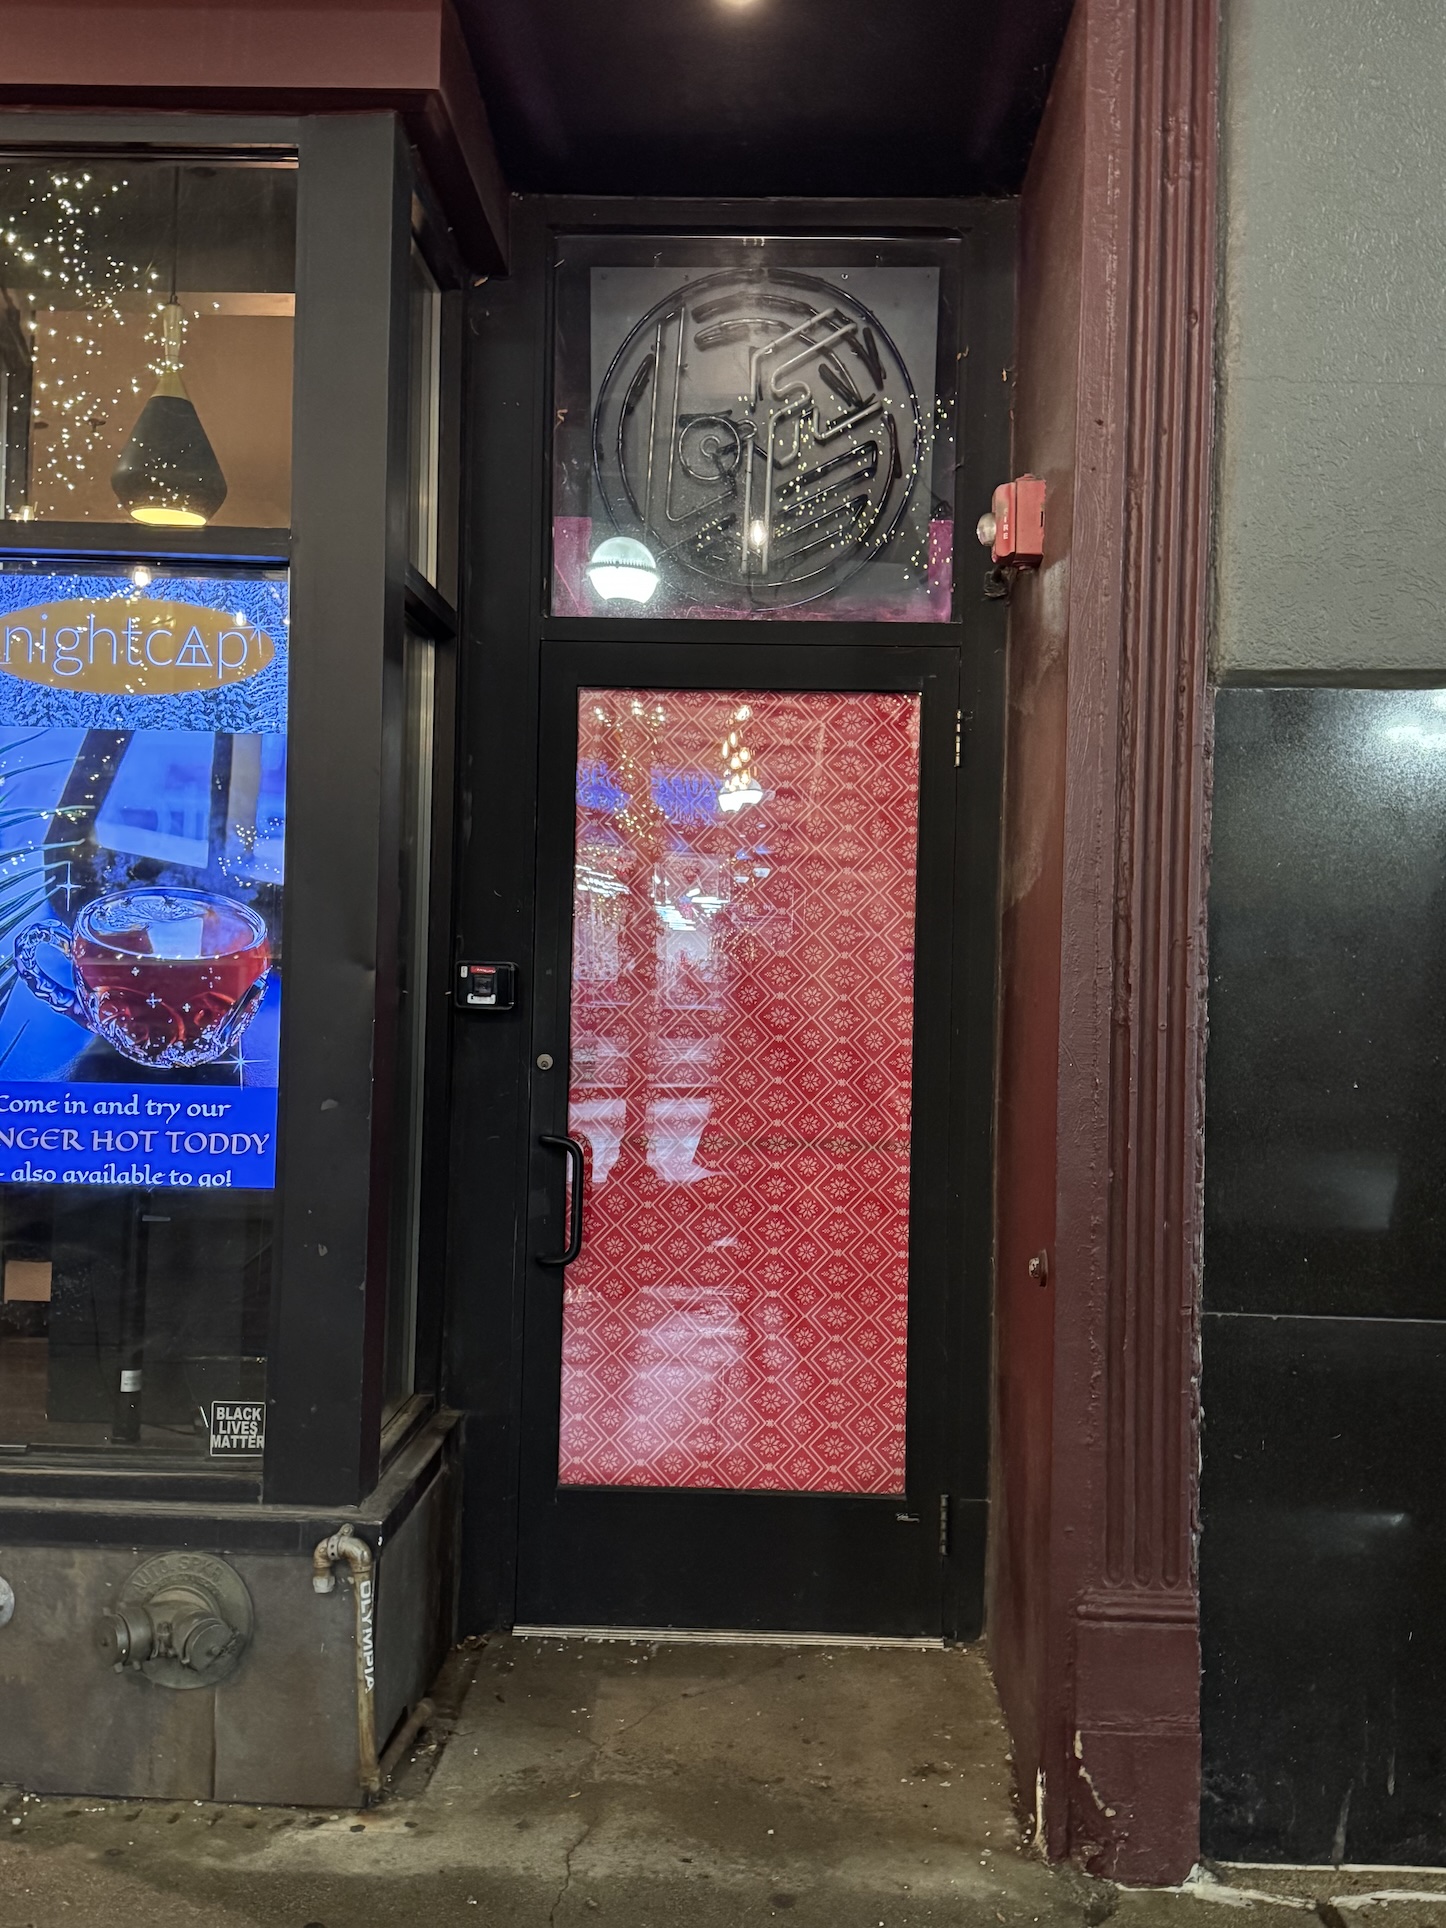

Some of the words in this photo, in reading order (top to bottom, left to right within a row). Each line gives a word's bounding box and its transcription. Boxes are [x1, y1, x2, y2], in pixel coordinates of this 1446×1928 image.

[0, 1094, 60, 1114] Come
[63, 1092, 88, 1115] in
[93, 1093, 140, 1116] and
[145, 1099, 181, 1125] try
[186, 1103, 232, 1118] our
[90, 1129, 159, 1153] HOT
[165, 1130, 270, 1155] TODDY
[11, 1160, 57, 1182] also
[62, 1162, 166, 1186] available
[168, 1169, 193, 1186] to
[216, 1406, 262, 1421] BLACK
[219, 1420, 259, 1436] LIVES
[212, 1434, 265, 1449] MATTER
[359, 1580, 375, 1694] OLYMPIA
